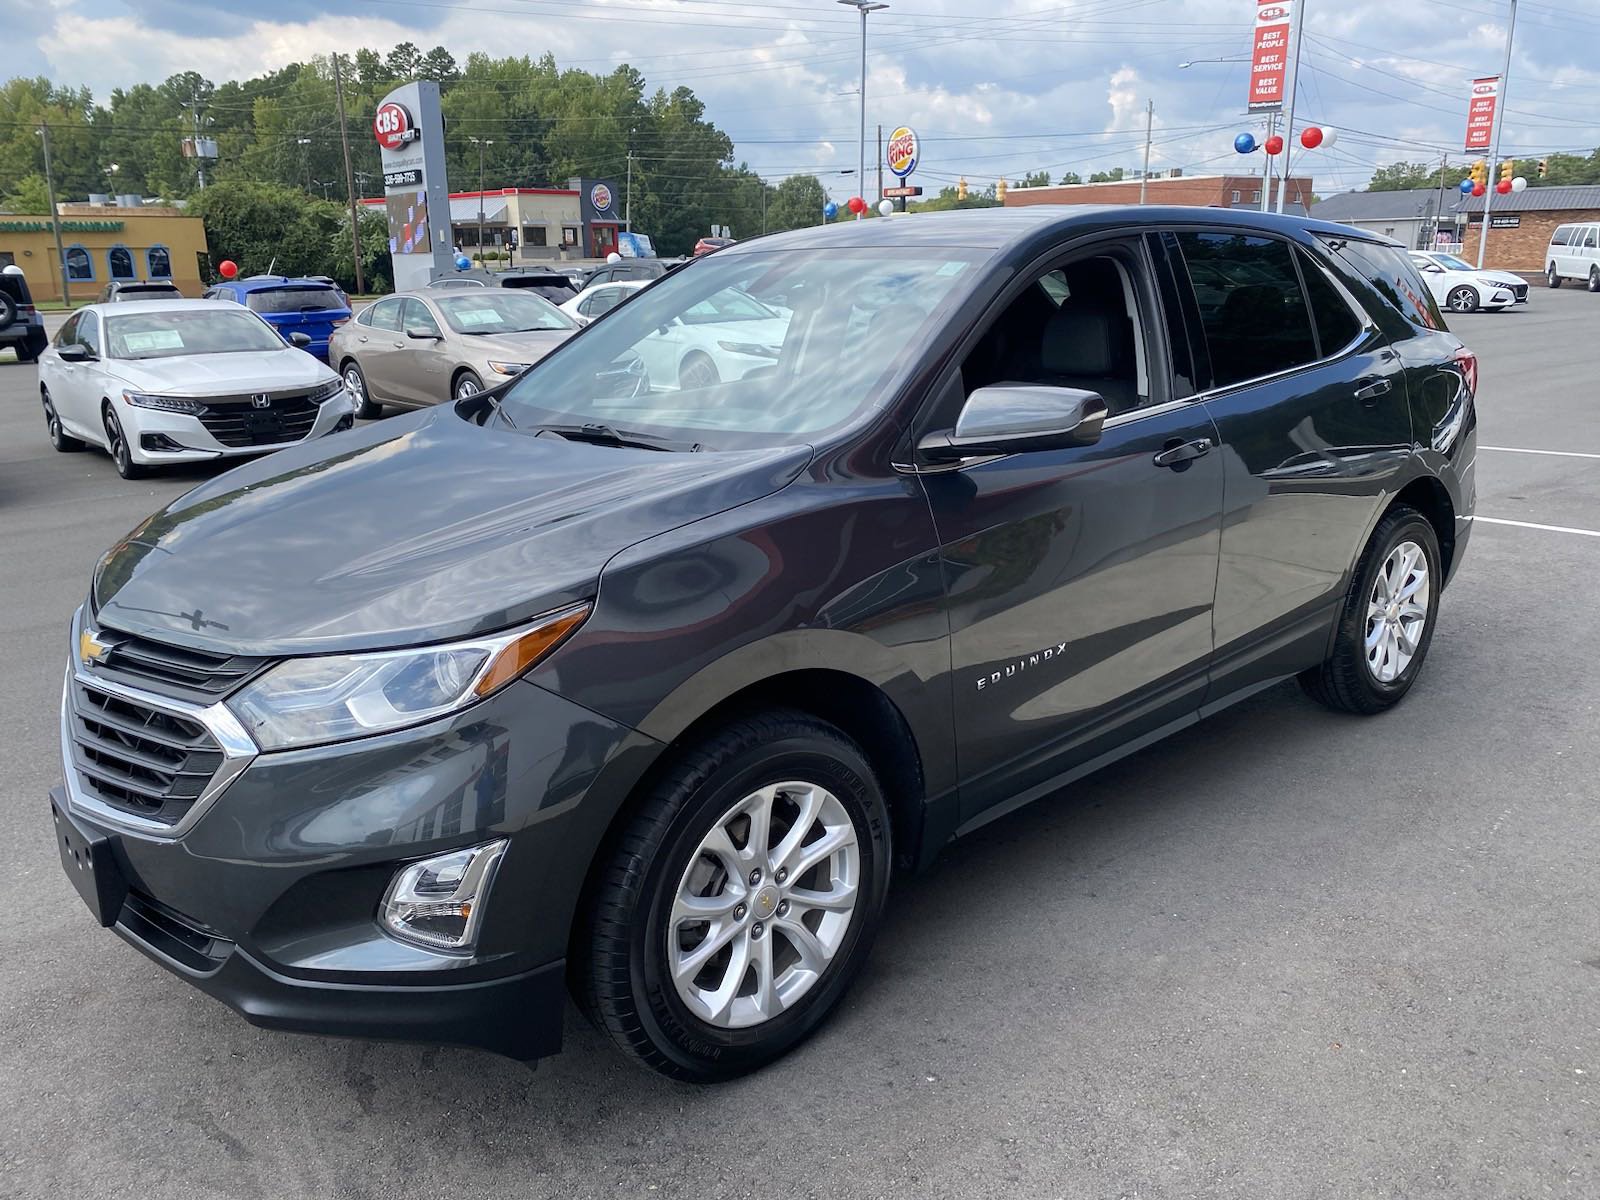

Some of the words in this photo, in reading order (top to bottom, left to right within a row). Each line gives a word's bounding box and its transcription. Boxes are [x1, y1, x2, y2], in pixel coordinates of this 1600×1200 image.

[1261, 8, 1281, 17] CBS
[1262, 31, 1281, 40] BEST
[1257, 39, 1284, 49] PEOPLE
[1260, 54, 1279, 63] BEST
[1253, 62, 1283, 73] SERVICE
[1258, 78, 1277, 86] BEST
[1255, 86, 1277, 95] VALUE
[376, 109, 400, 134] CBS
[889, 134, 913, 152] BURGER
[889, 142, 914, 165] KING
[47, 221, 125, 233] RSTAURANT
[976, 642, 1066, 690] EQUINOX
